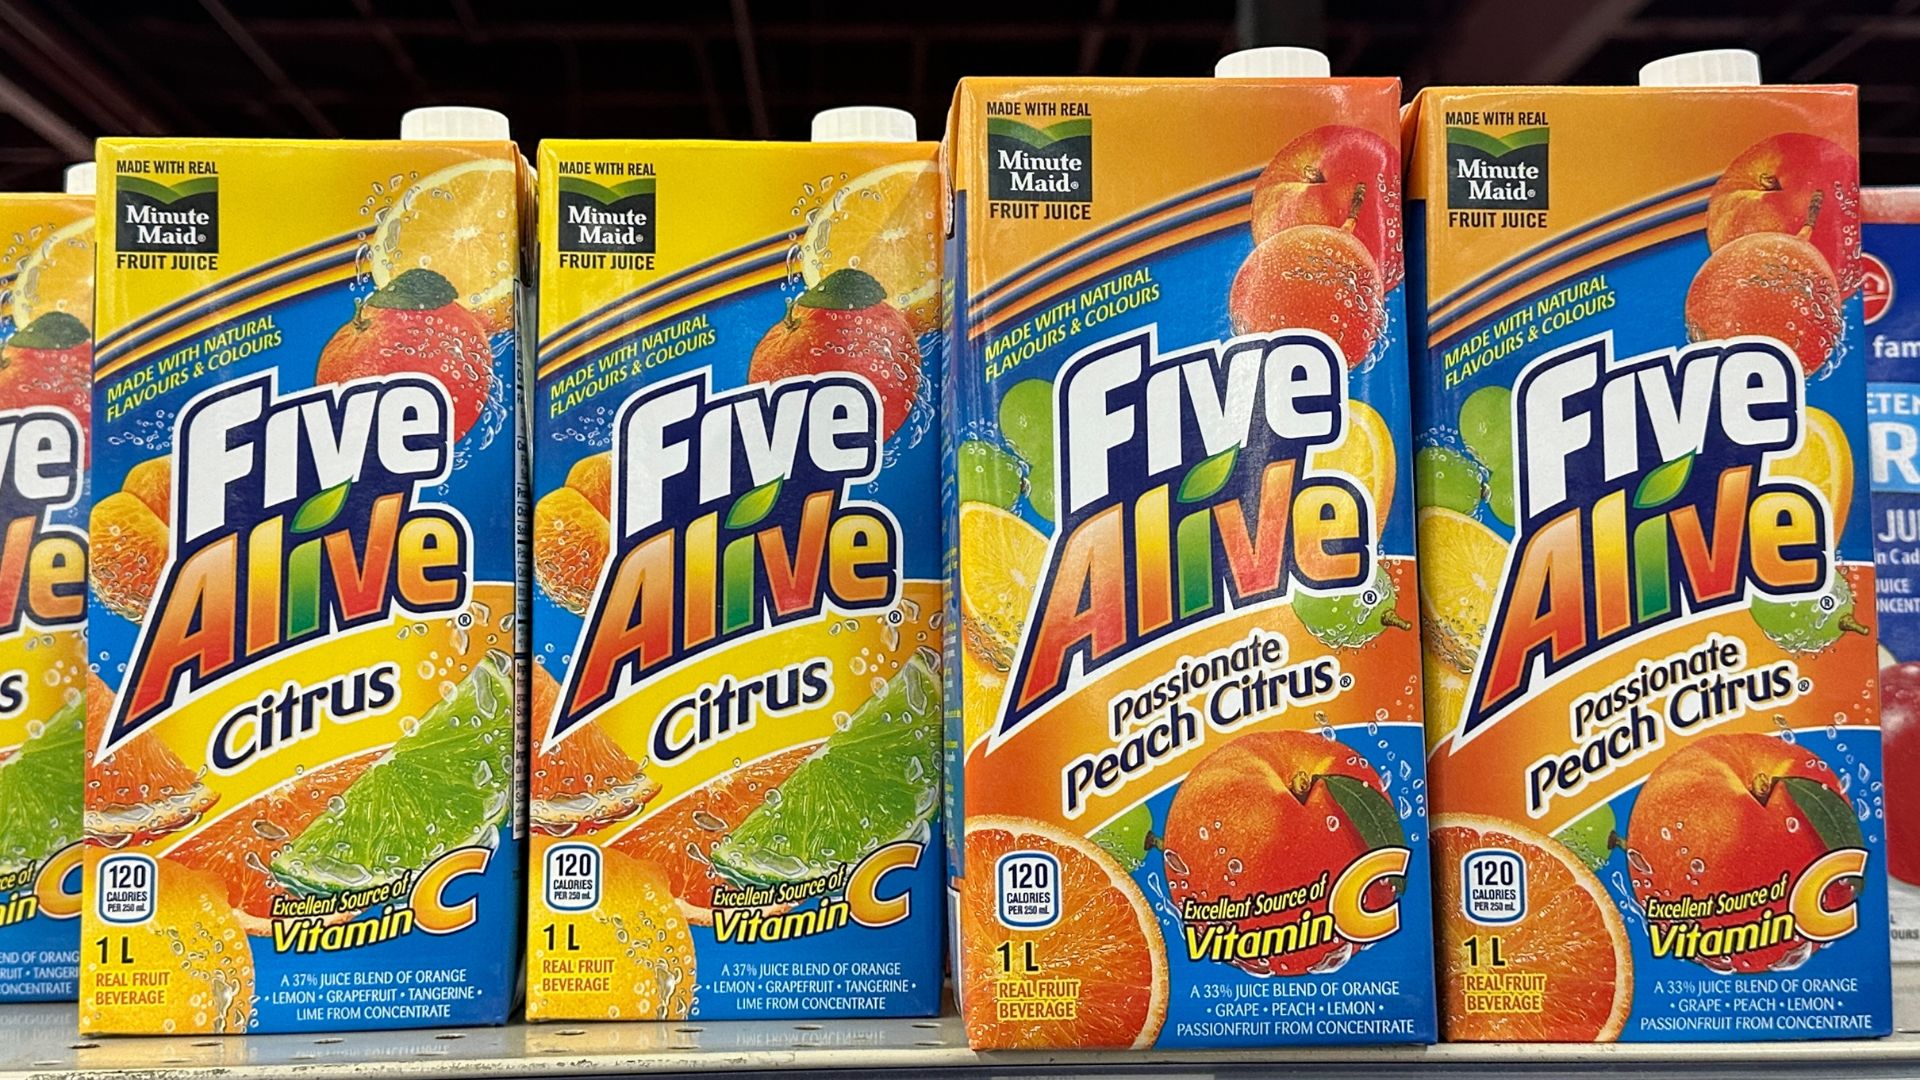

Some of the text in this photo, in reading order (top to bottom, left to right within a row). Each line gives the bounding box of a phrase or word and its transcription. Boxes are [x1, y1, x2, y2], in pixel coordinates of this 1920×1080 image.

[987, 101, 1091, 116] MADE WITH REAL
[1446, 112, 1548, 125] MADE WITH REAL
[117, 160, 218, 174] MADE WITH REAL
[559, 162, 656, 176] MADE WITH REAL
[998, 149, 1082, 171] Minute
[1456, 158, 1539, 179] Minute
[126, 205, 209, 225] Minute
[568, 205, 646, 226] Minute
[990, 203, 1091, 220] FRUIT JUICE
[1449, 212, 1547, 228] FRUIT JUICE
[117, 254, 218, 270] FRUIT JUICE
[560, 254, 654, 270] FRUIT JUICE
[985, 267, 1152, 362] MADE WITH NATURAL
[1445, 275, 1608, 369] MADE WITH NATURAL
[985, 284, 1159, 383] FLAVOURS & COLOURS
[1445, 292, 1615, 389] FLAVOURS & COLOURS
[107, 314, 276, 403] MADE WITH NATURAL
[551, 314, 709, 400] MADE WITH NATURAL
[107, 331, 282, 423] FLAVOURS & COLOURS
[551, 330, 716, 419] FLAVOURS & COLOURS
[1066, 342, 1333, 514] Five
[1524, 347, 1789, 519] Five
[185, 384, 442, 544] Five
[625, 384, 870, 539] Five
[1114, 633, 1282, 733] Passionate
[1575, 638, 1739, 736] Passionate
[213, 667, 395, 769] Citrus
[652, 661, 828, 761] Citrus
[1067, 708, 1196, 812] Peach
[1530, 710, 1655, 811] Peach
[18, 860, 35, 885] of
[109, 865, 146, 888] 120
[555, 853, 591, 877] 120
[1008, 863, 1048, 889] 120
[1473, 861, 1513, 886] 120
[34, 841, 83, 920] C
[553, 879, 592, 890] CALORIES
[713, 864, 847, 906] Excellent Source of
[106, 891, 147, 902] CALORIES
[272, 847, 493, 953] Vitamin C
[273, 871, 412, 916] Excellent Source of
[713, 842, 923, 943] Vitamin C
[1006, 892, 1050, 903] CALORIES
[1184, 872, 1328, 920] Excellent Source of
[1186, 847, 1411, 960] Vitamin C
[1472, 889, 1516, 900] CALORIES
[1648, 873, 1788, 918] Excellent Source of
[1650, 848, 1869, 958] Vitamin C
[0, 951, 80, 963] END OF ORANG
[96, 936, 134, 963] 1 L
[997, 942, 1038, 972] 1 L
[34, 967, 79, 979] TANGERI
[543, 959, 615, 974] REAL FRUIT
[96, 972, 170, 987] REAL FRUIT
[280, 969, 466, 989] A 37% JUICE BLEND OF ORANGE
[542, 977, 610, 992] BEVERAGE
[1000, 981, 1079, 998] REAL FRUIT
[1467, 975, 1545, 991] REAL FRUIT
[1654, 978, 1858, 997] A 33% JUICE BLEND OF ORANGE
[96, 990, 165, 1005] BEVERAGE
[273, 986, 474, 1005] LEMON GRAPEFRUIT TANGERINE
[1190, 981, 1400, 1001] A 33% JUICE BLEND OF ORANGE
[1467, 995, 1540, 1010] BEVERAGE
[297, 1004, 450, 1020] LIME FROM CONCENTRATE
[999, 1001, 1073, 1018] BEVERAGE
[1215, 1001, 1375, 1017] GRAPE PEACH LEMON
[1177, 1019, 1414, 1037] PASSIONFRUIT FROM CONCENTRATE
